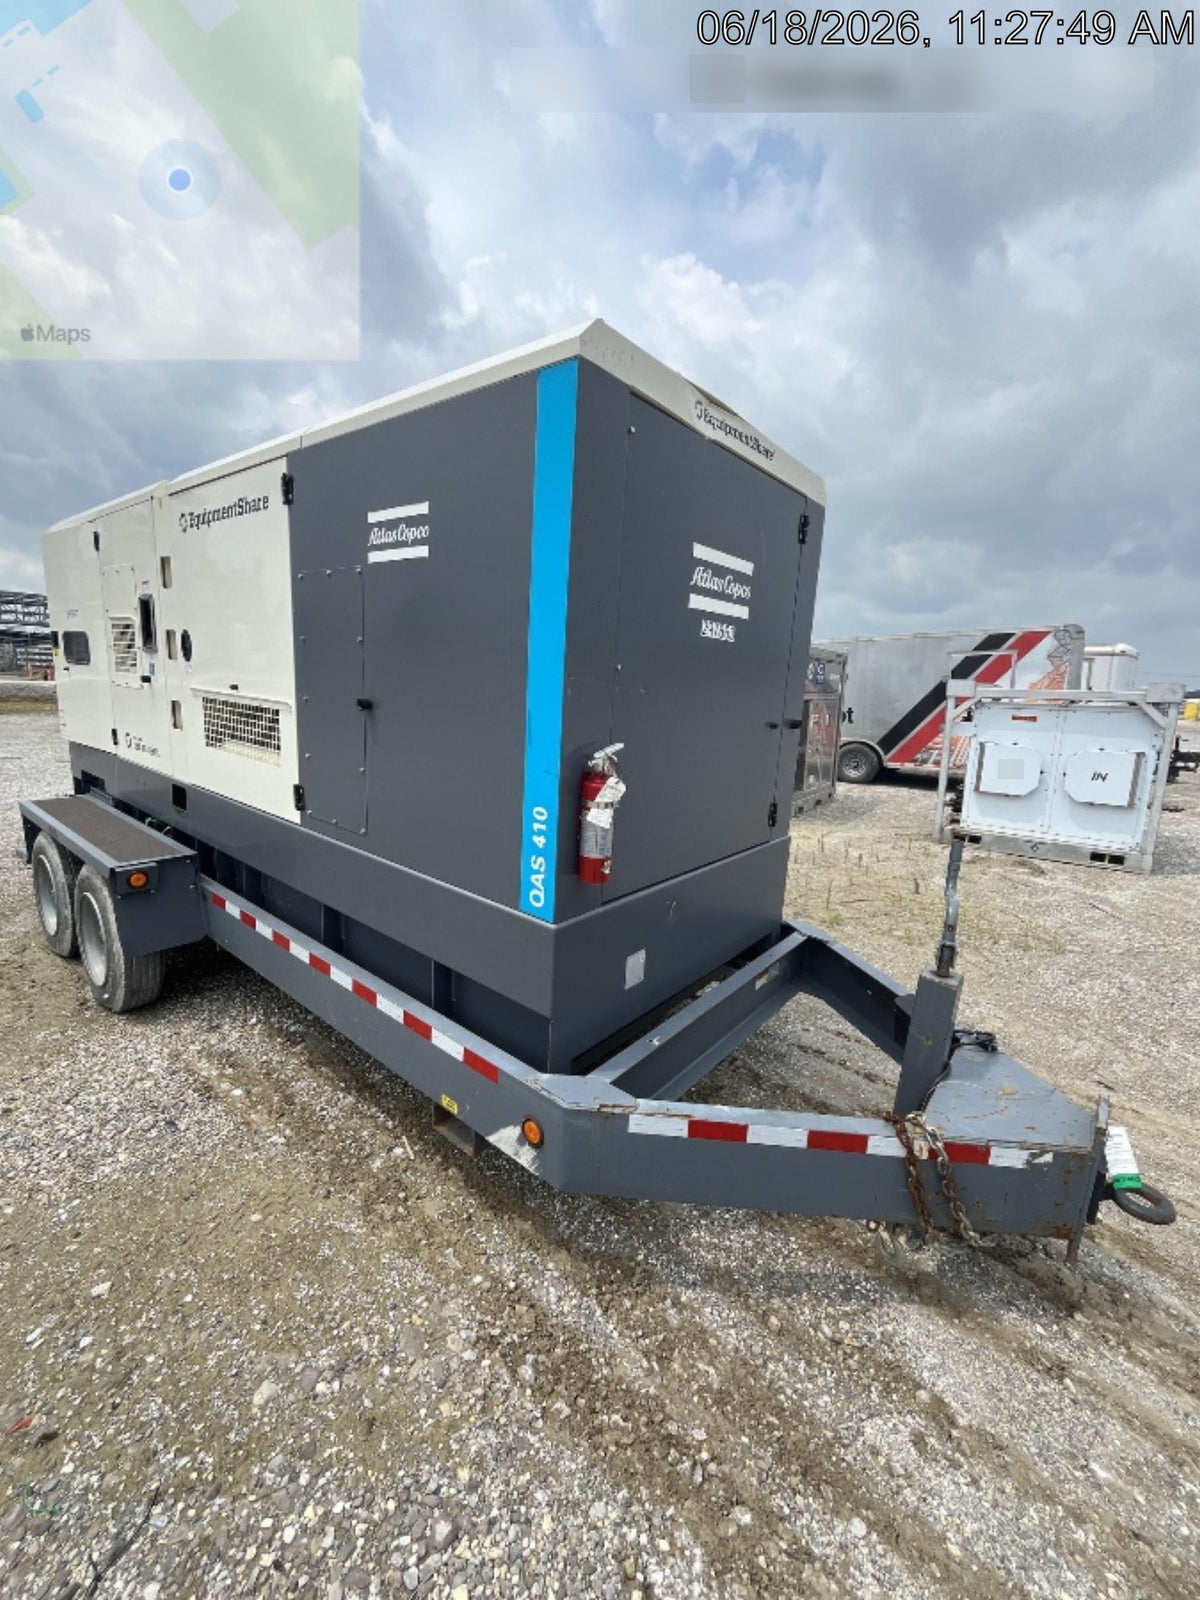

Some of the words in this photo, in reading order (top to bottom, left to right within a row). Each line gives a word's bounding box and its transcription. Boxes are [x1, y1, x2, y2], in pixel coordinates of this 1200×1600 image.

[189, 495, 270, 530] EquipmentShare
[532, 806, 549, 849] 410
[528, 854, 546, 908] QAS
